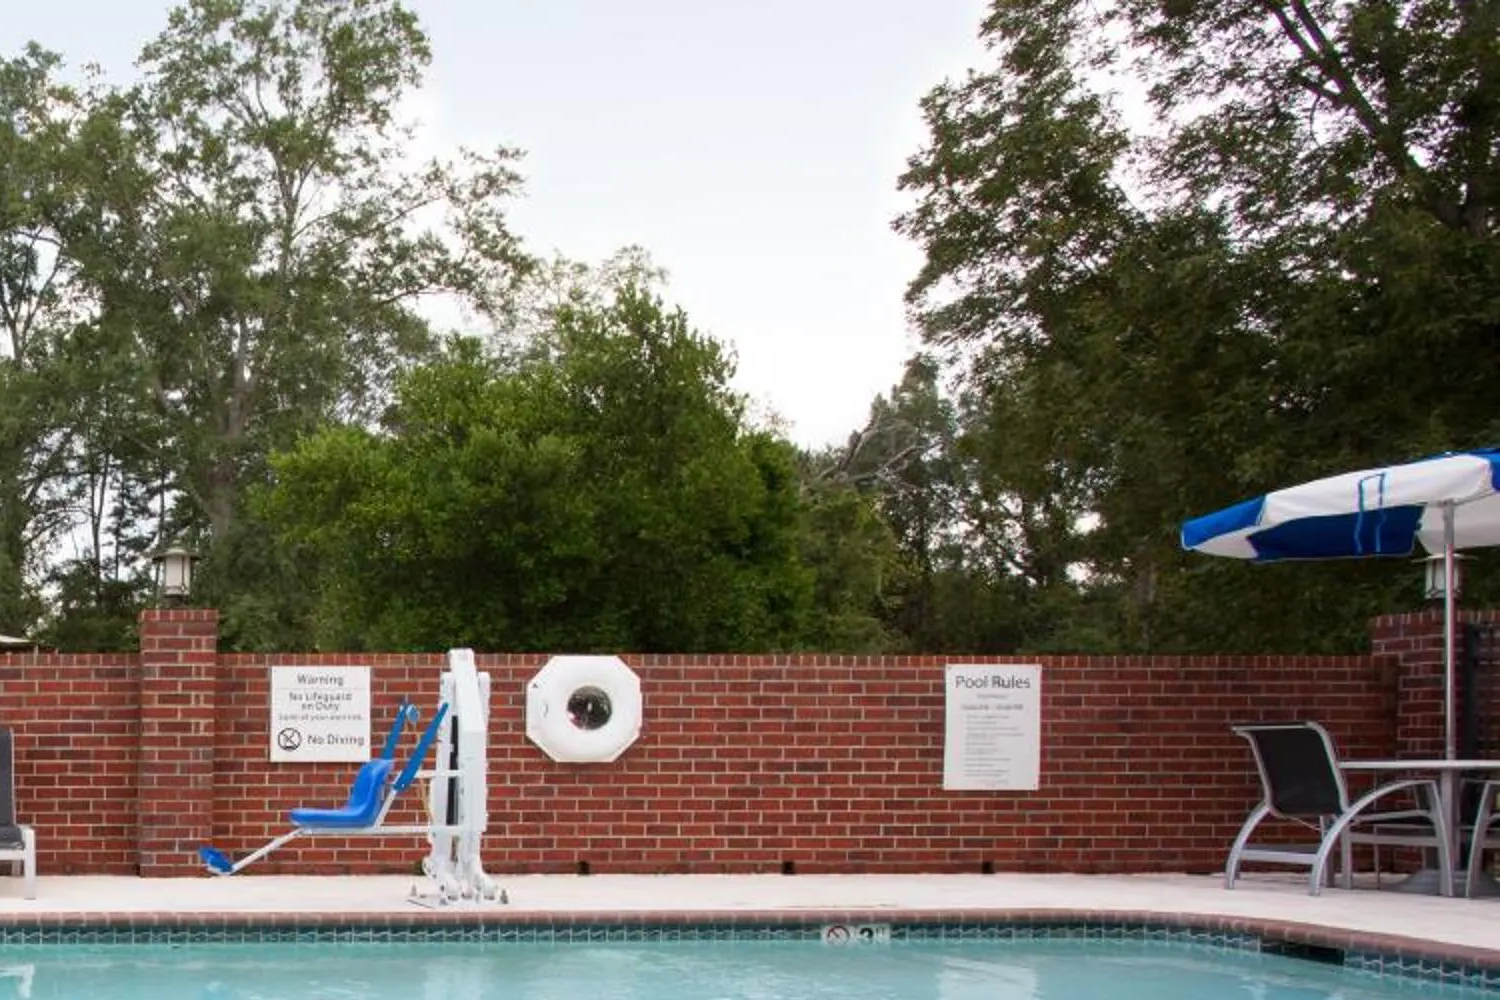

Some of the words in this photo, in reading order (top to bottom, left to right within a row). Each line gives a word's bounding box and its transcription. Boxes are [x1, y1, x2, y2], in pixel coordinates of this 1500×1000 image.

[297, 674, 344, 686] Warning
[955, 675, 988, 689] Pool
[991, 675, 1031, 689] Rules
[289, 691, 303, 701] No
[305, 691, 353, 702] Lifeguard
[315, 702, 339, 711] Duty
[307, 734, 325, 744] No
[327, 733, 365, 746] Diving
